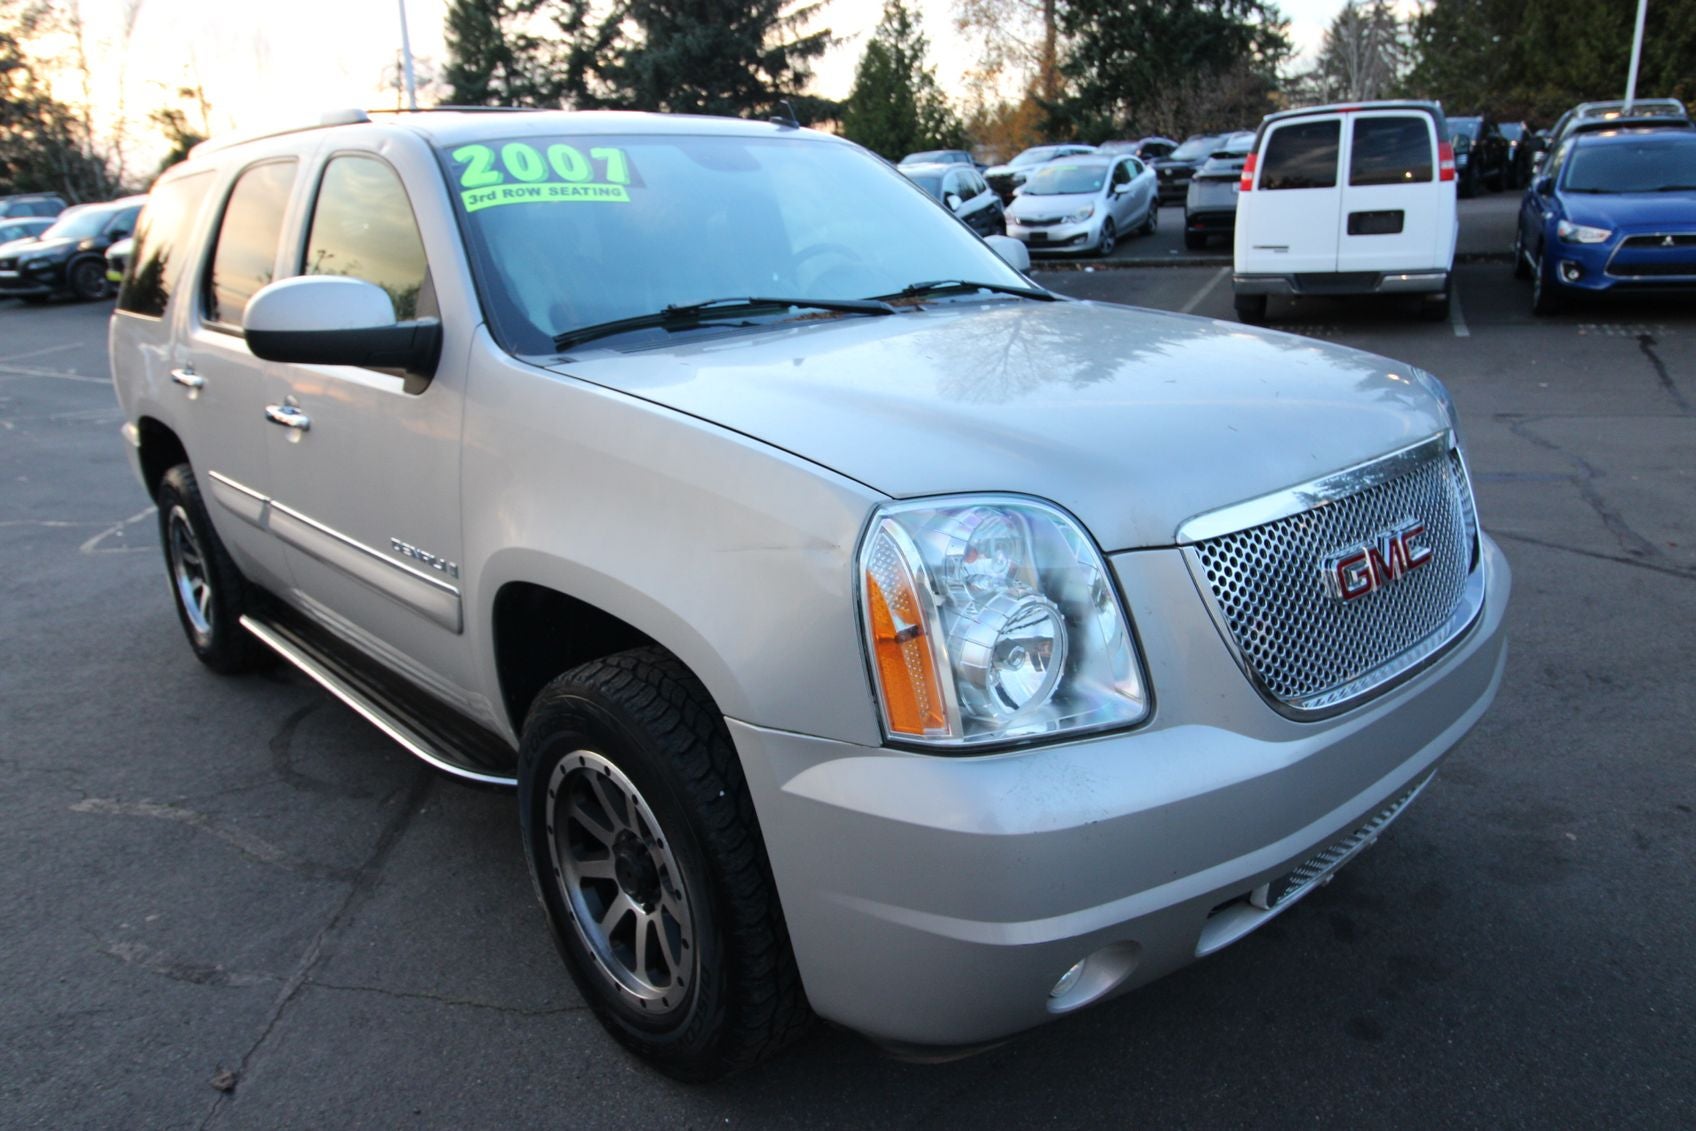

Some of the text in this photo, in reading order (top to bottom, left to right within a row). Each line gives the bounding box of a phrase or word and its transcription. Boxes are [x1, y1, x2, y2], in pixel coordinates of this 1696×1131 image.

[452, 142, 631, 188] 2007
[468, 186, 623, 206] 3rd ROW SEATING
[1320, 517, 1433, 603] GMC
